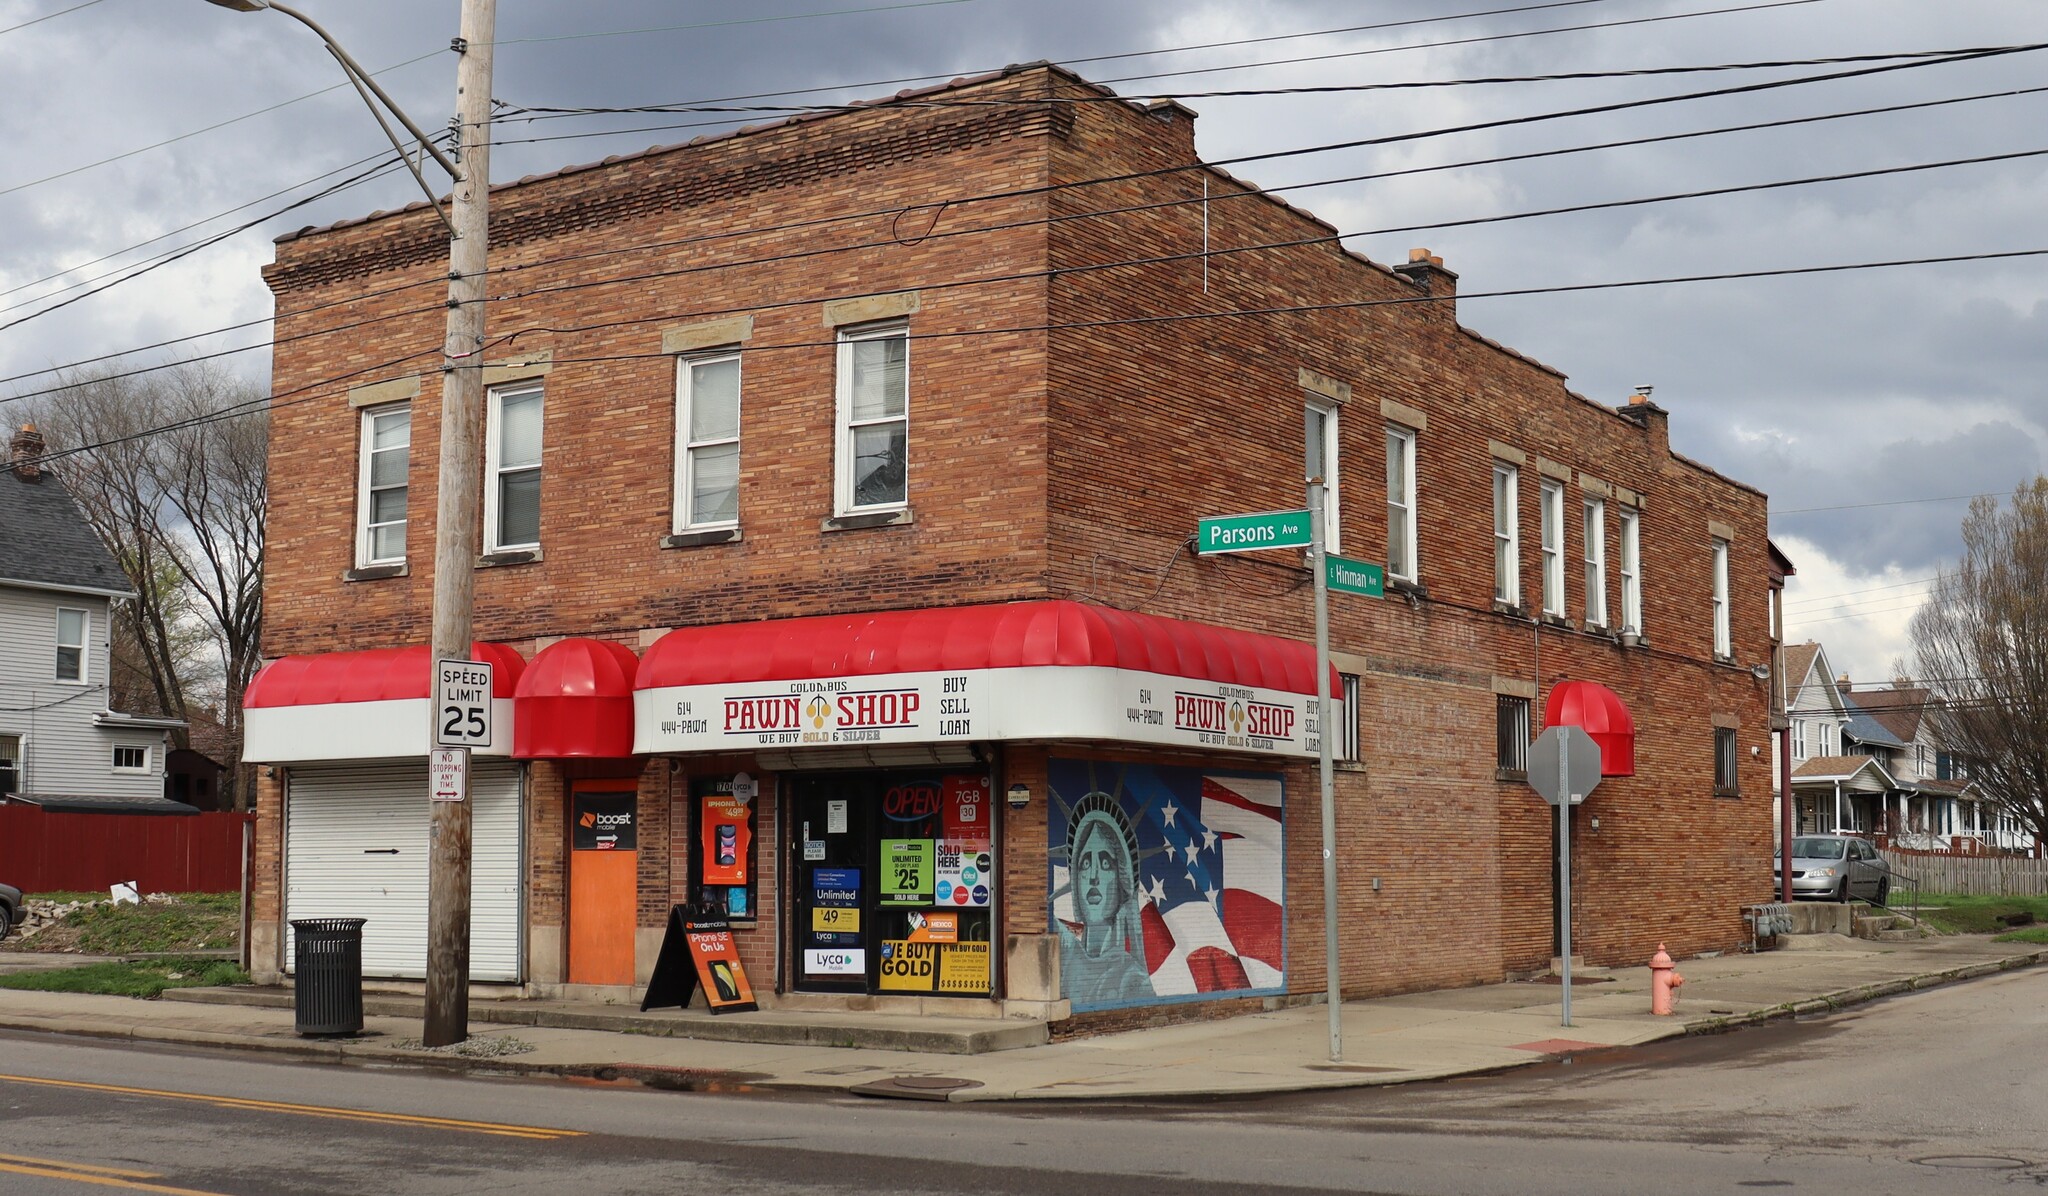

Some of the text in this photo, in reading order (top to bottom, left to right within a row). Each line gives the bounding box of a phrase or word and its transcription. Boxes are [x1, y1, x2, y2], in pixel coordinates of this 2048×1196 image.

[1211, 524, 1298, 545] Parsons Ave
[1330, 564, 1377, 588] E Hinman Ave
[443, 670, 488, 685] SPEED
[943, 677, 967, 693] BUY
[447, 688, 482, 702] LIMIT
[1140, 689, 1151, 704] 614
[1219, 686, 1254, 700] COLUMBUS
[677, 701, 691, 715] 614
[724, 693, 920, 730] PAWN SHOP
[940, 698, 970, 714] SELL
[1306, 700, 1319, 714] BUY
[444, 706, 486, 738] 25
[1127, 708, 1163, 725] 444-PAWN
[1175, 695, 1294, 737] PAWN SHOP
[661, 719, 707, 734] 444-PAWN
[940, 719, 970, 735] LOAN
[1305, 719, 1320, 733] SELL
[759, 730, 880, 744] WE BUY GOLD & SILVER
[1199, 733, 1273, 750] WE BUY GOLD & SILVER
[442, 754, 453, 762] NO
[433, 764, 462, 773] STOPPING
[884, 787, 943, 814] OPEN
[955, 790, 980, 803] 7GB
[596, 812, 631, 825] boost
[937, 845, 961, 856] SOLD
[892, 855, 922, 863] UNLIMITED
[937, 857, 960, 868] HERE
[894, 868, 919, 890] $25
[817, 890, 856, 900] Unlimited
[820, 910, 838, 923] $49
[690, 932, 728, 942] iPhone SE
[816, 932, 832, 941] Lyca
[701, 942, 725, 952] On Us
[906, 943, 933, 959] BUY
[950, 944, 958, 952] WE
[959, 944, 971, 952] BUY
[972, 944, 987, 952] GOLD
[817, 952, 843, 967] Lyca
[882, 960, 932, 977] GOLD
